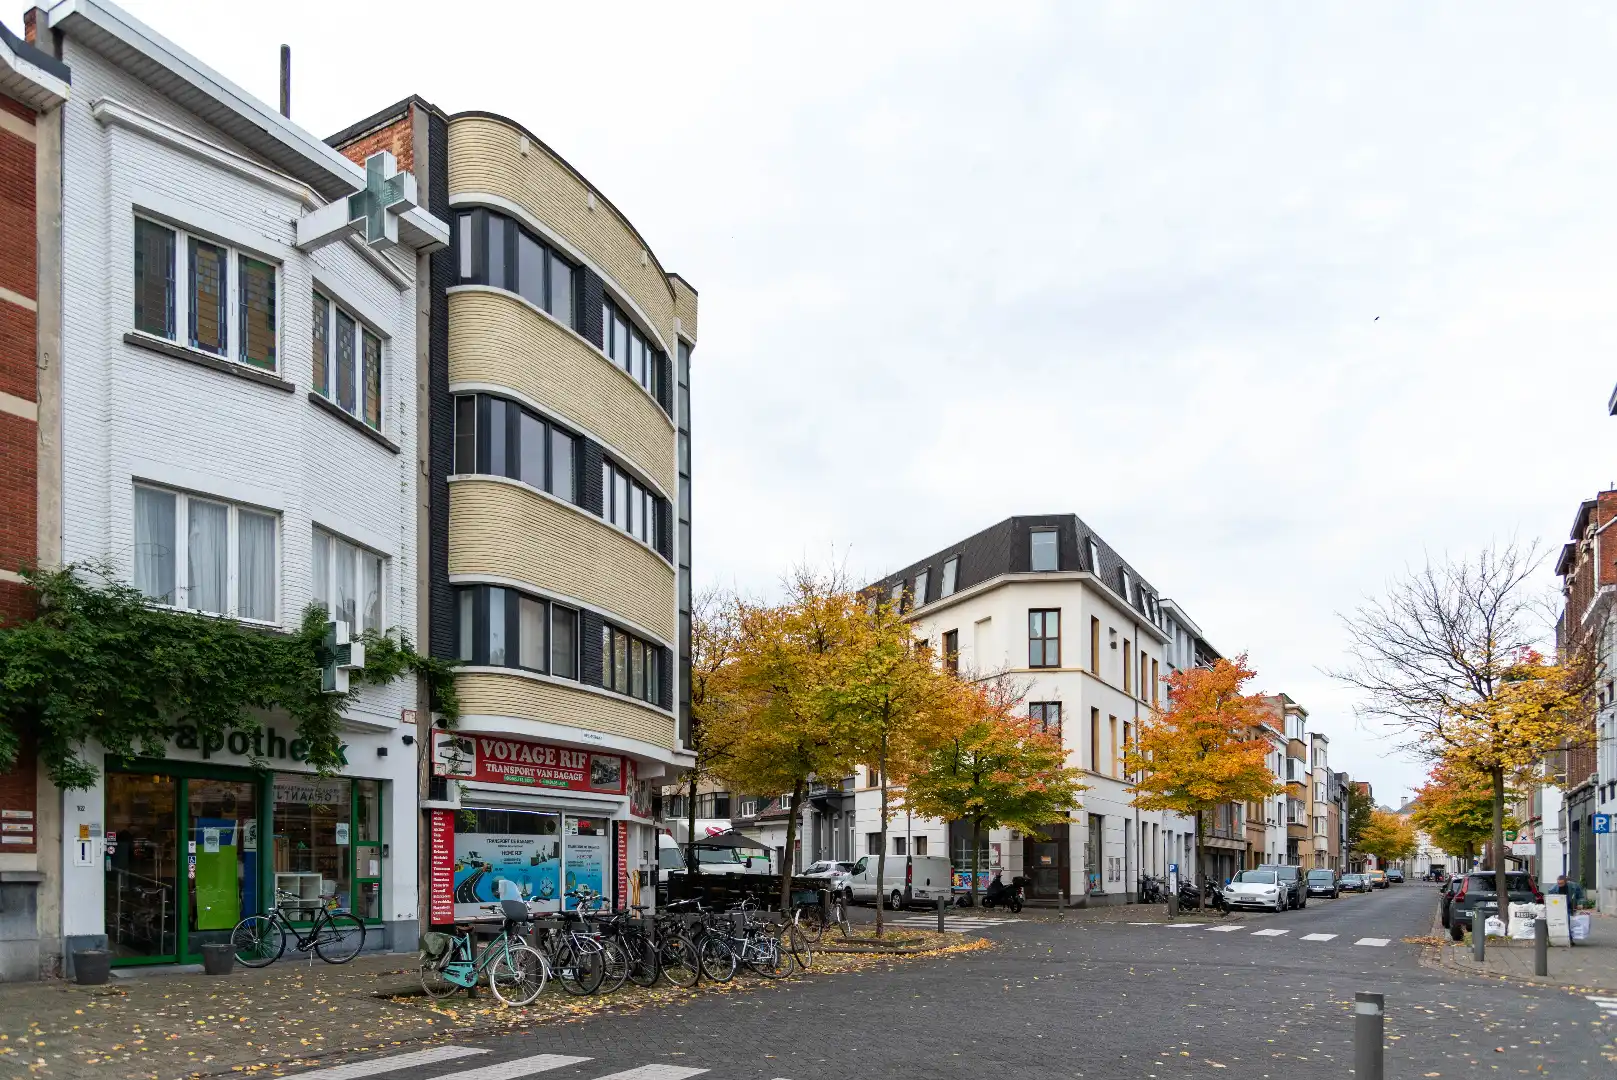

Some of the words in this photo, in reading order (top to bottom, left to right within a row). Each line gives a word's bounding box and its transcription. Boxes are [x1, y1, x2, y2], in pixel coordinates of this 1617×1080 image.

[175, 724, 349, 766] apothek
[481, 739, 556, 765] VOYAGE
[559, 750, 587, 768] RIF
[486, 763, 535, 776] TRANSPORT
[536, 769, 553, 778] VAN
[553, 772, 583, 781] BAGAGE
[1595, 816, 1607, 831] P
